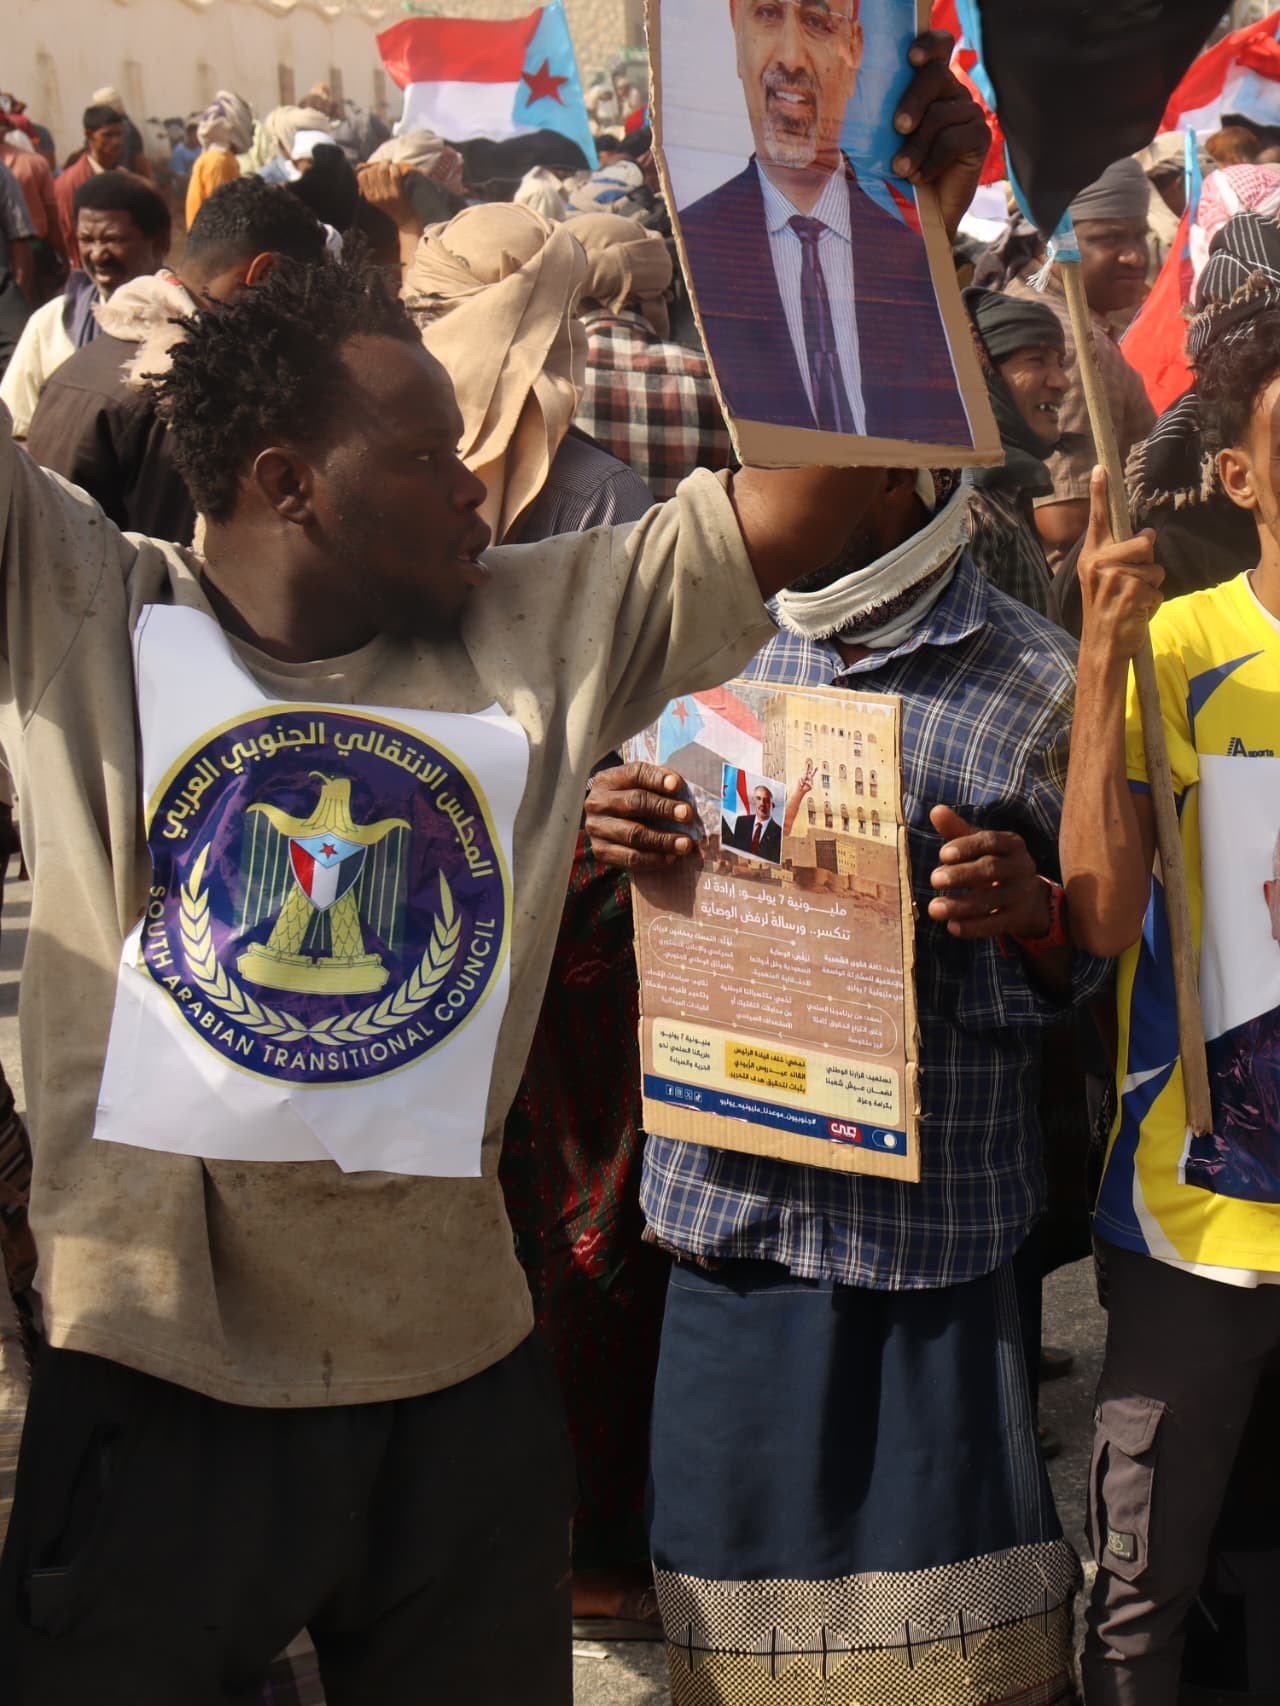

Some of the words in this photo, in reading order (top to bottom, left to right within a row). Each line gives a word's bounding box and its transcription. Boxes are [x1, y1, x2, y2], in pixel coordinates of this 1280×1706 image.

[222, 722, 325, 773] الجنوبي
[335, 729, 445, 790] الانتقالي
[163, 757, 220, 840] العربي
[436, 790, 493, 878] المجلس
[701, 902, 737, 919] الوصاية
[704, 880, 711, 890] لا
[779, 894, 784, 904] 7
[741, 912, 769, 927] لرفض
[148, 885, 174, 970] SOUTH
[163, 974, 255, 1056] ARABIAN
[262, 1022, 434, 1072] TRANSITIONAL
[434, 918, 496, 1023] COUNCIL
